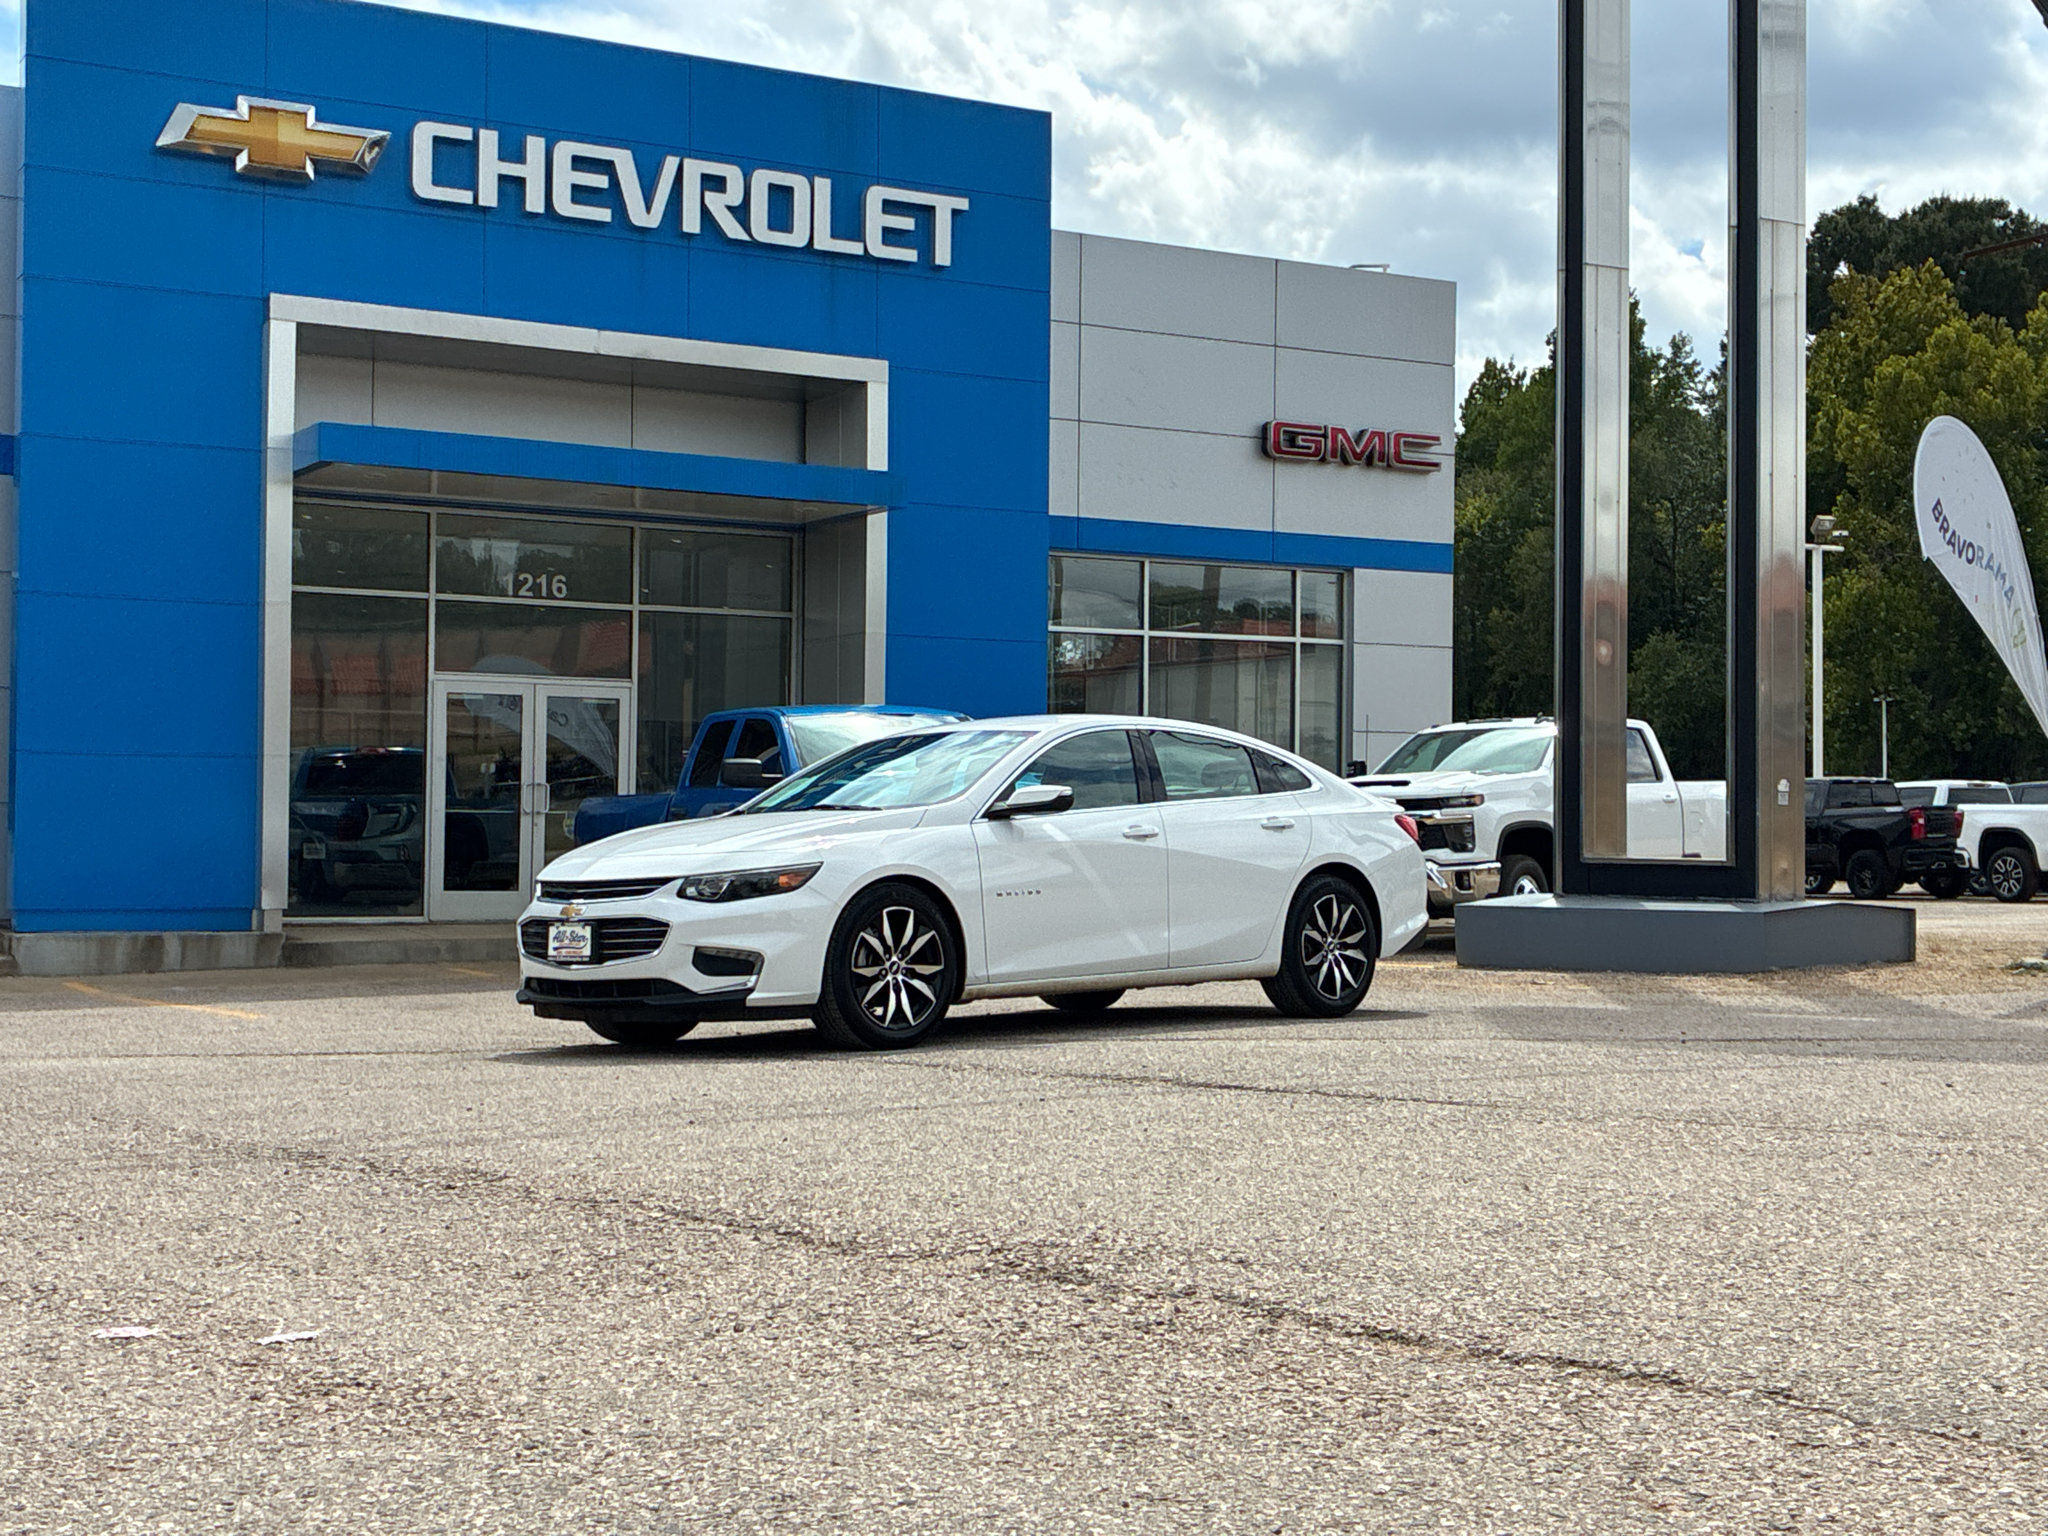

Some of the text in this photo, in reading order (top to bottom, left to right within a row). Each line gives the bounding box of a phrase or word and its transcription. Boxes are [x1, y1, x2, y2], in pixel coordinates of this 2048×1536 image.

[410, 121, 970, 268] CHEVROLET
[1267, 420, 1442, 471] GMC
[503, 572, 568, 599] 1216
[1931, 498, 2015, 609] BRAVORAMA
